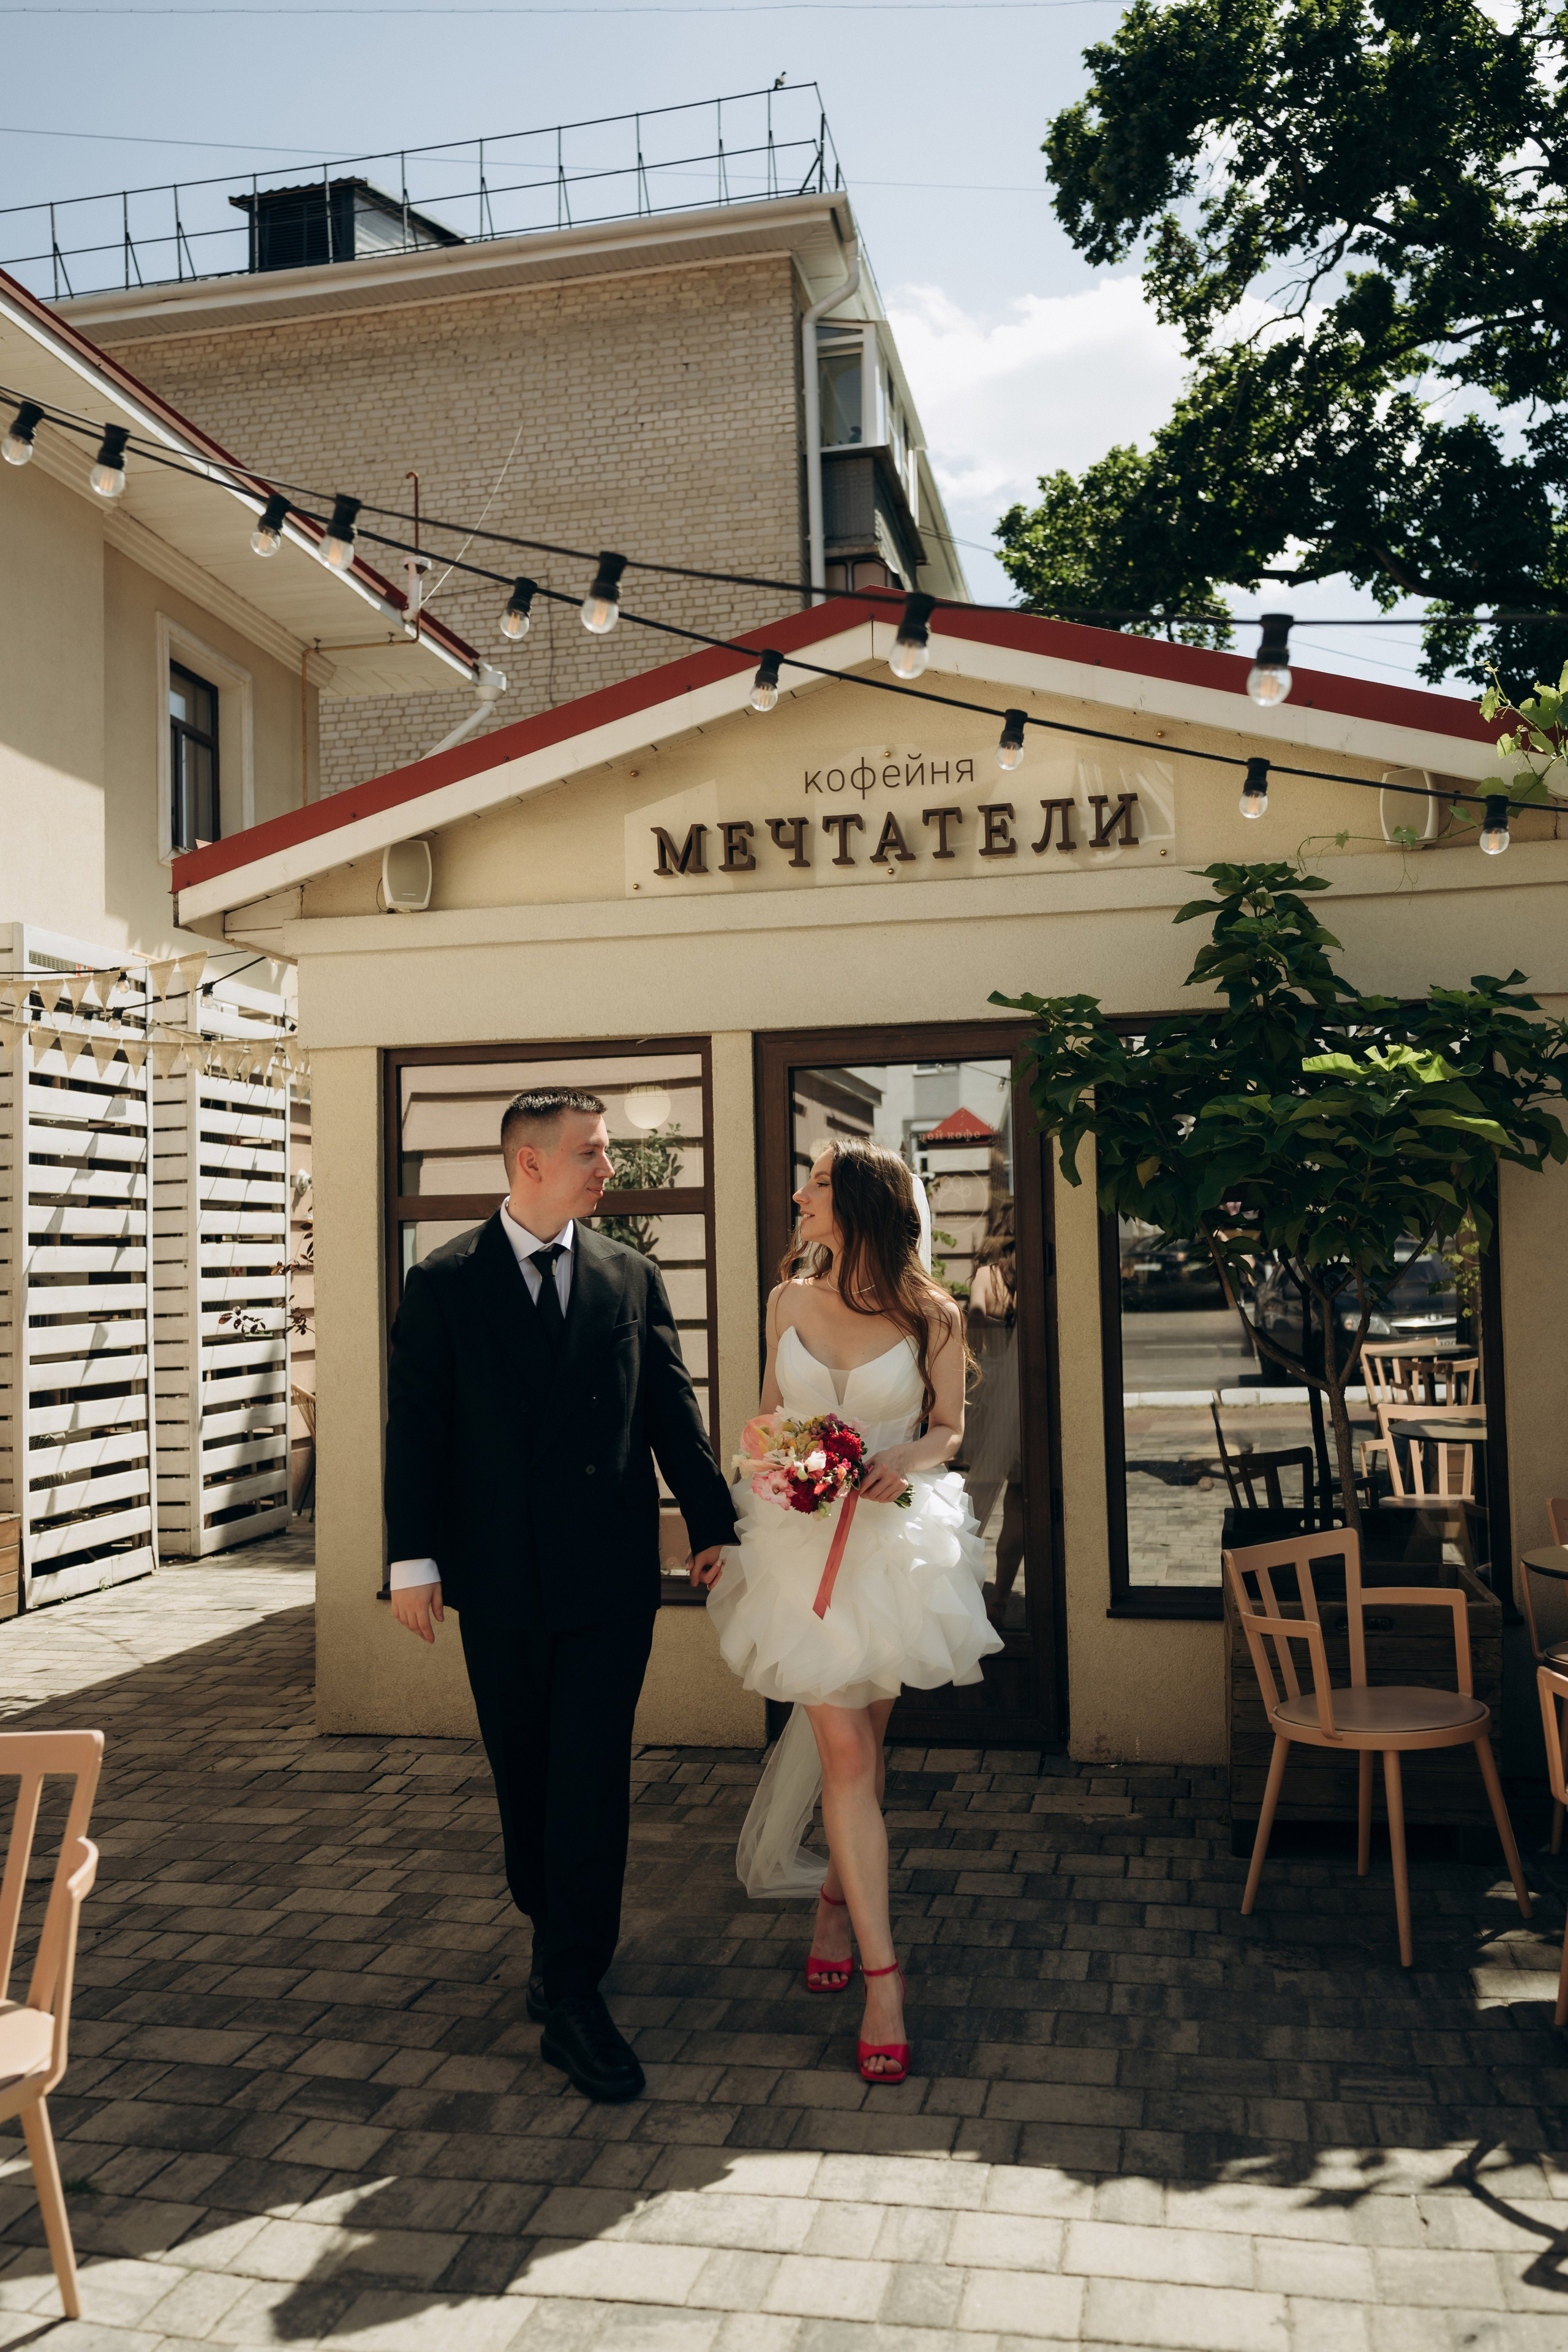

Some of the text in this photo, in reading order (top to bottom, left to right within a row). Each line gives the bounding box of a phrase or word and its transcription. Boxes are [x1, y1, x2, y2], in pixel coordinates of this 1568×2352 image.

[804, 753, 974, 800] кофейня
[650, 793, 1139, 876] МЕЧТАТЕЛИ
[947, 1129, 981, 1142] кофе
